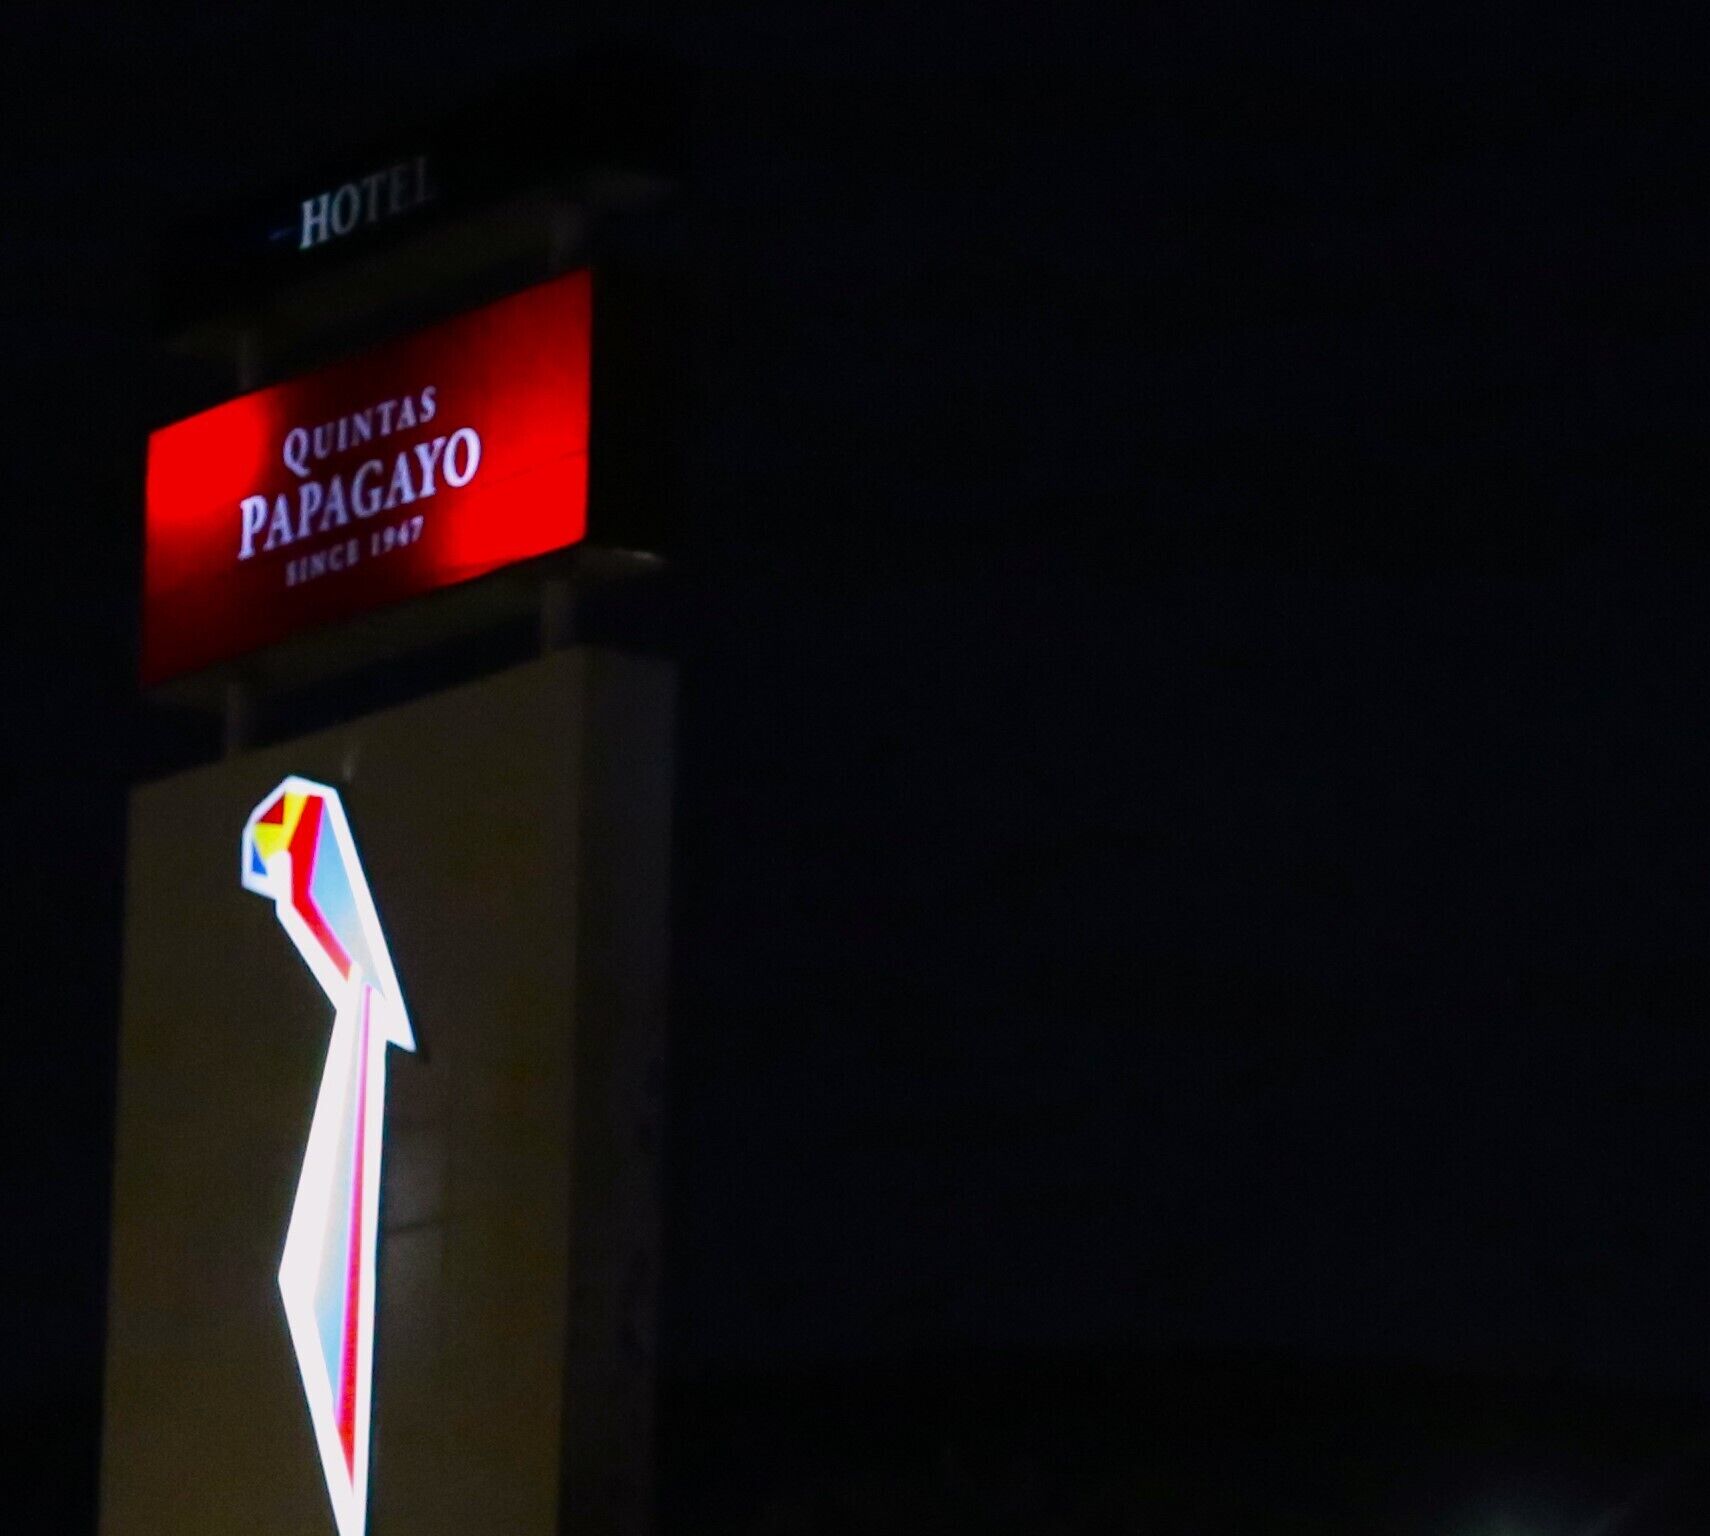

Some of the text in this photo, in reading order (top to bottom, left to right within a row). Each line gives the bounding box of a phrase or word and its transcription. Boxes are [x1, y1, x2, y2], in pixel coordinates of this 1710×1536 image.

[299, 156, 430, 250] HOTEL
[283, 386, 436, 478] QUINTAS
[238, 427, 481, 560] PAPAGAYO
[286, 538, 359, 587] SINCE
